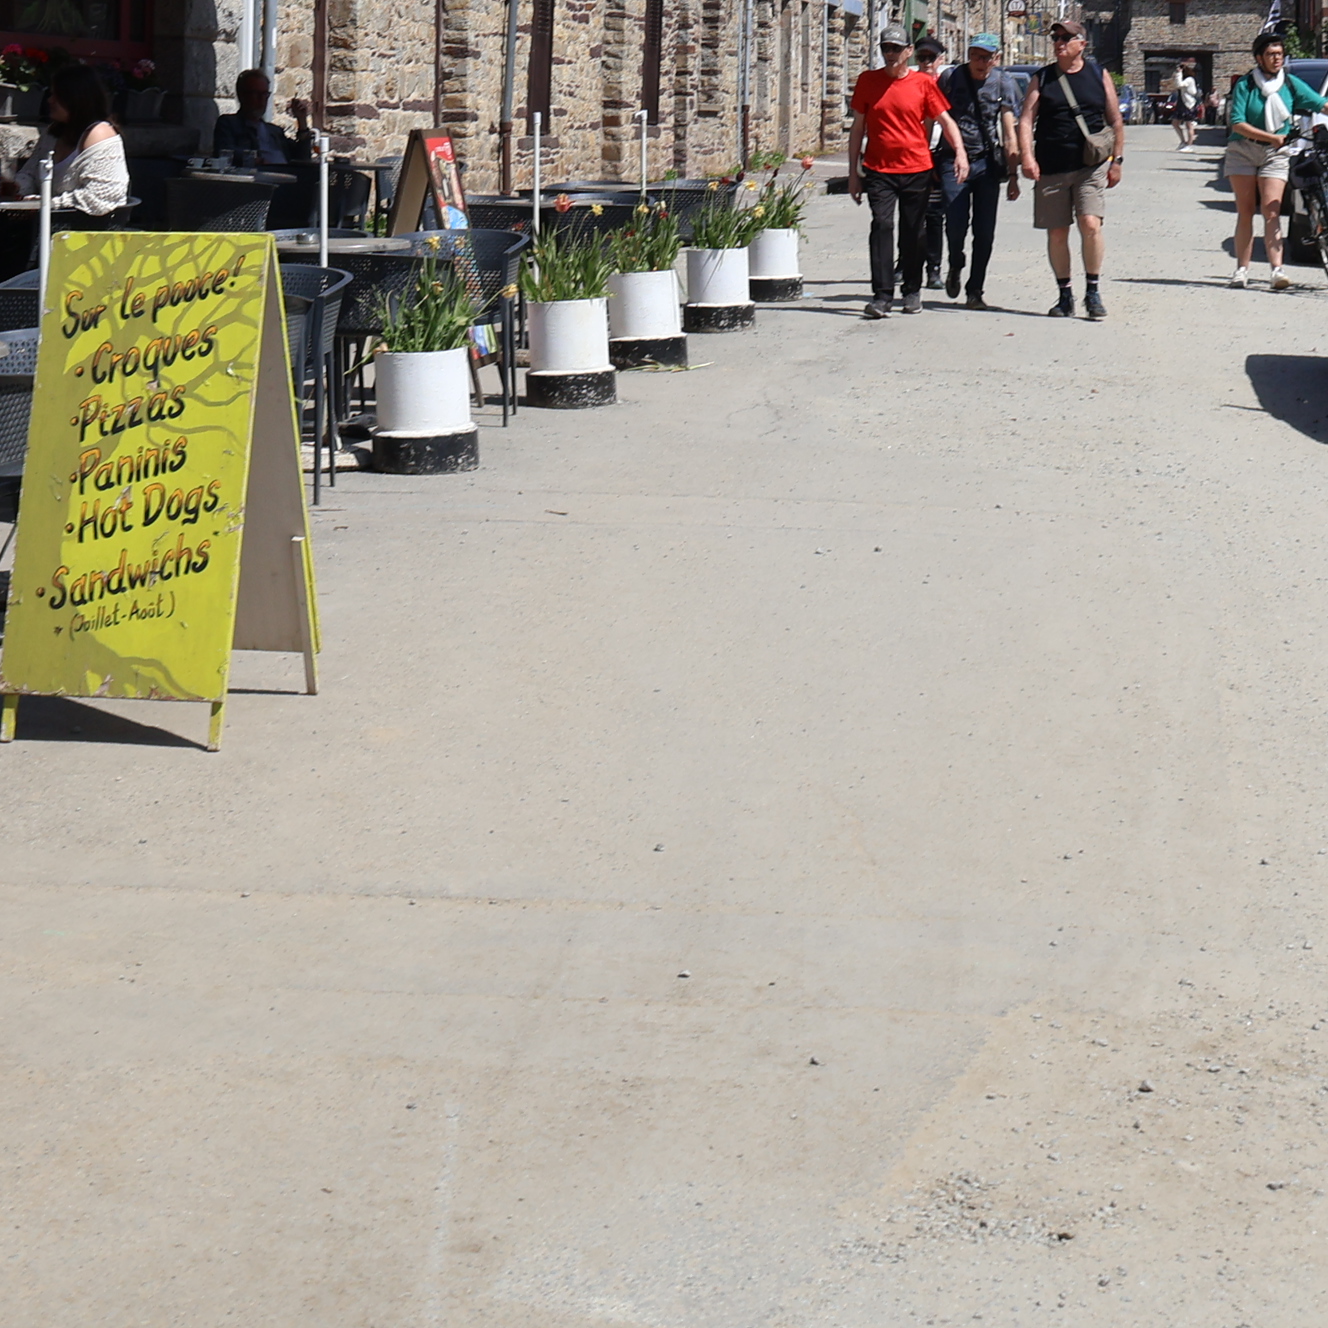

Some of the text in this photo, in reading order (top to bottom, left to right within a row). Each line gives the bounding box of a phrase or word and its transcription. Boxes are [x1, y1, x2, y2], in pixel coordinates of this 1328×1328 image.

[62, 289, 107, 339] Sur
[120, 275, 146, 321] le
[92, 324, 218, 387] Croques
[79, 384, 186, 443] Pizzas
[79, 435, 188, 495] Paninis
[77, 479, 221, 544] Hot Dogs
[48, 532, 212, 610] Sandwichs
